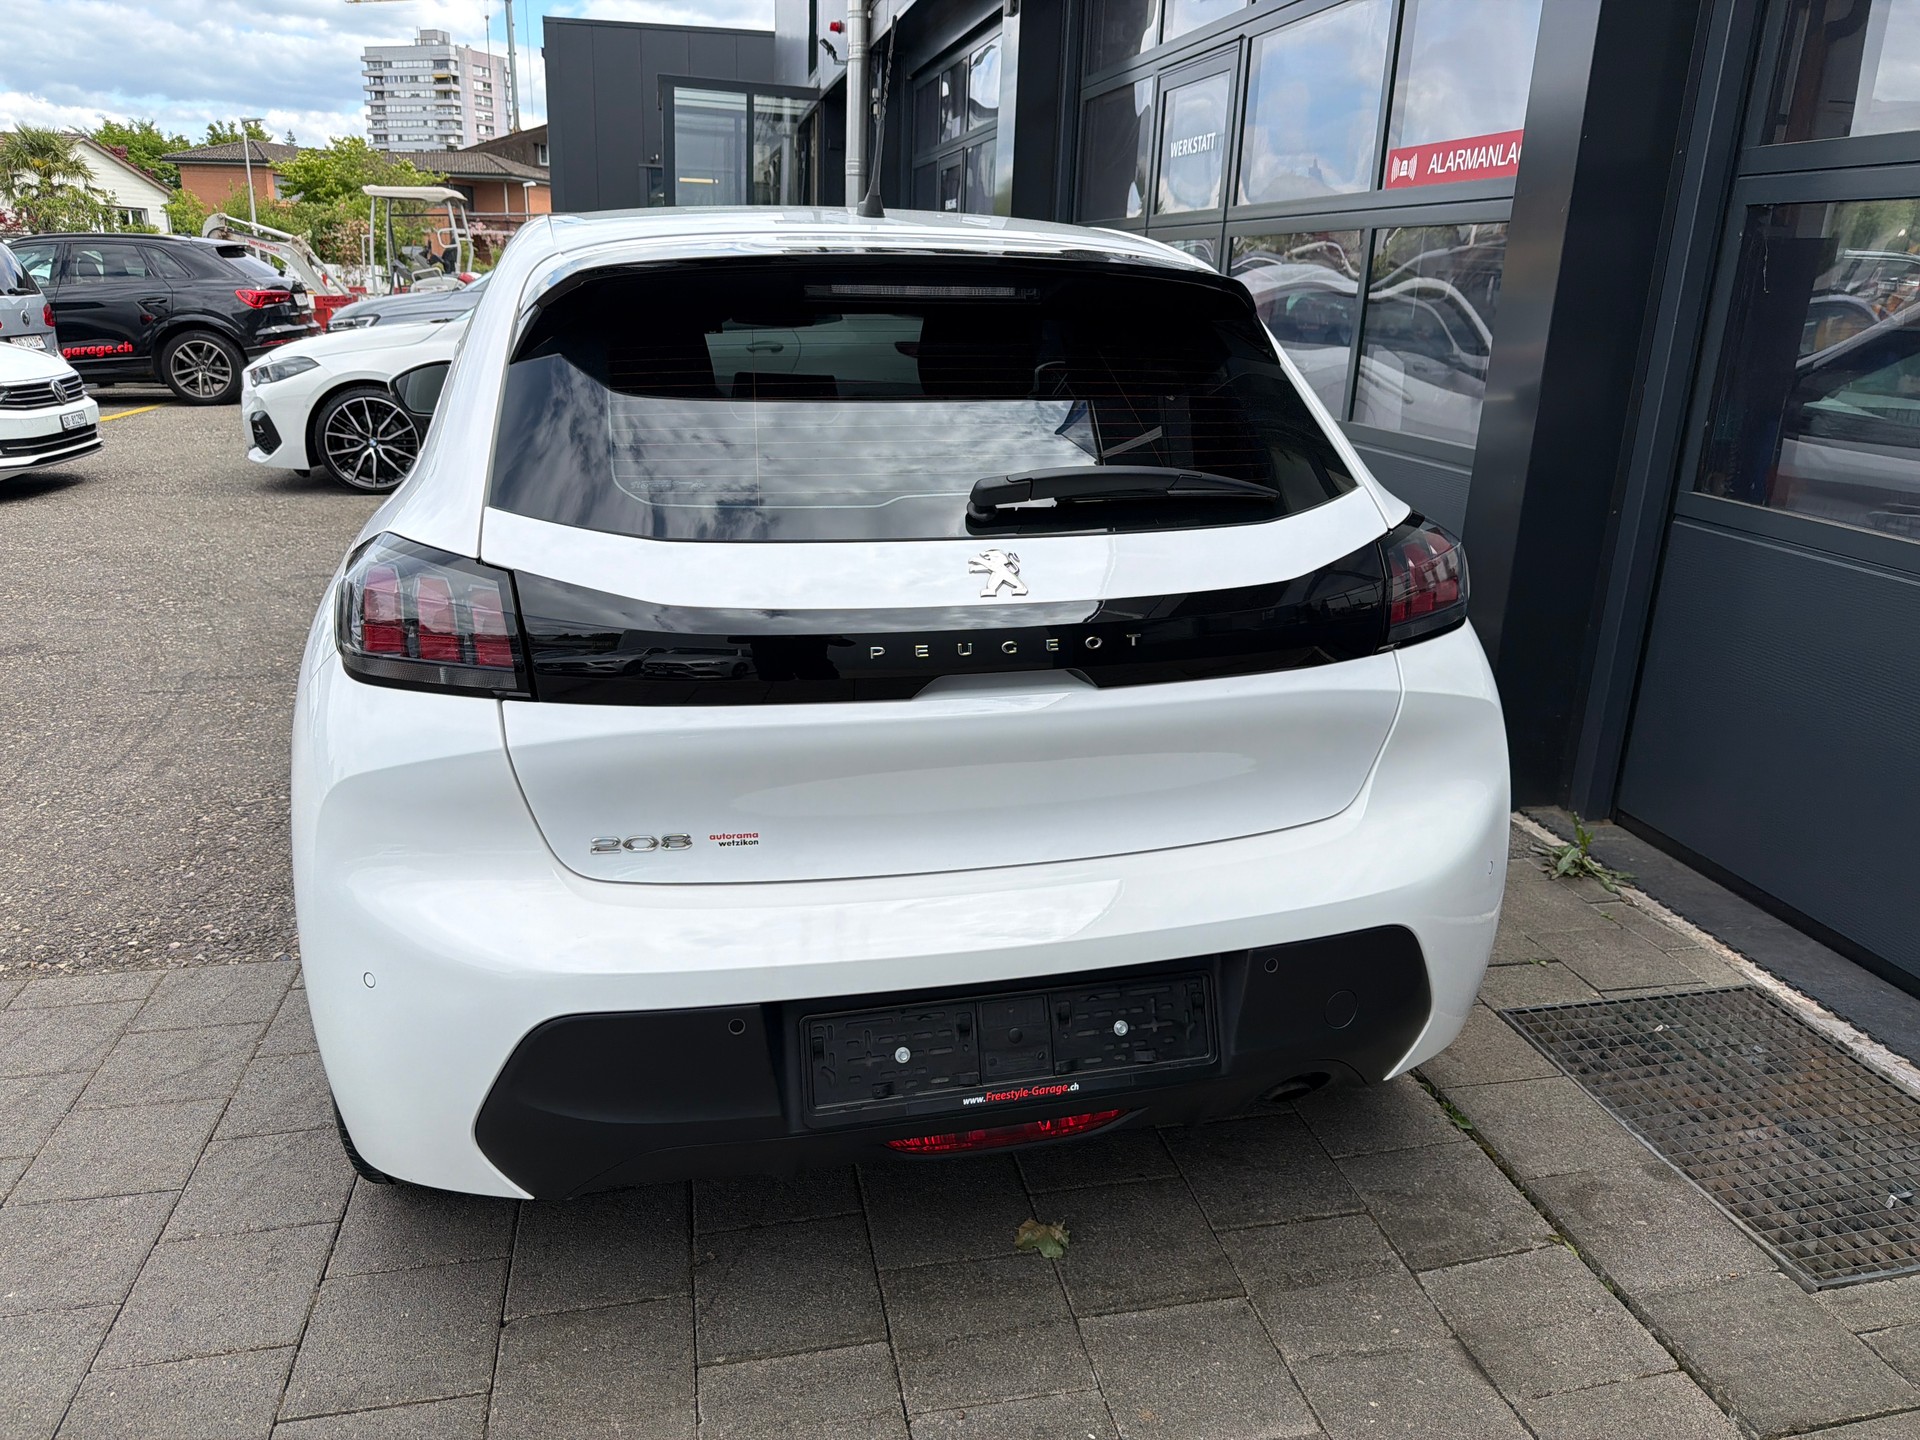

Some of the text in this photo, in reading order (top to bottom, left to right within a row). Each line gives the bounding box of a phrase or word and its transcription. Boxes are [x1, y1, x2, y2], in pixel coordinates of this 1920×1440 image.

[1170, 132, 1216, 158] WERKSTATT
[62, 341, 133, 358] garage.ch
[869, 633, 1142, 660] PEUGEOT
[590, 833, 693, 855] 208
[709, 831, 759, 841] autorama
[718, 838, 759, 847] wetzikon
[962, 1082, 1080, 1106] www.Freestyle-Garage.ch
